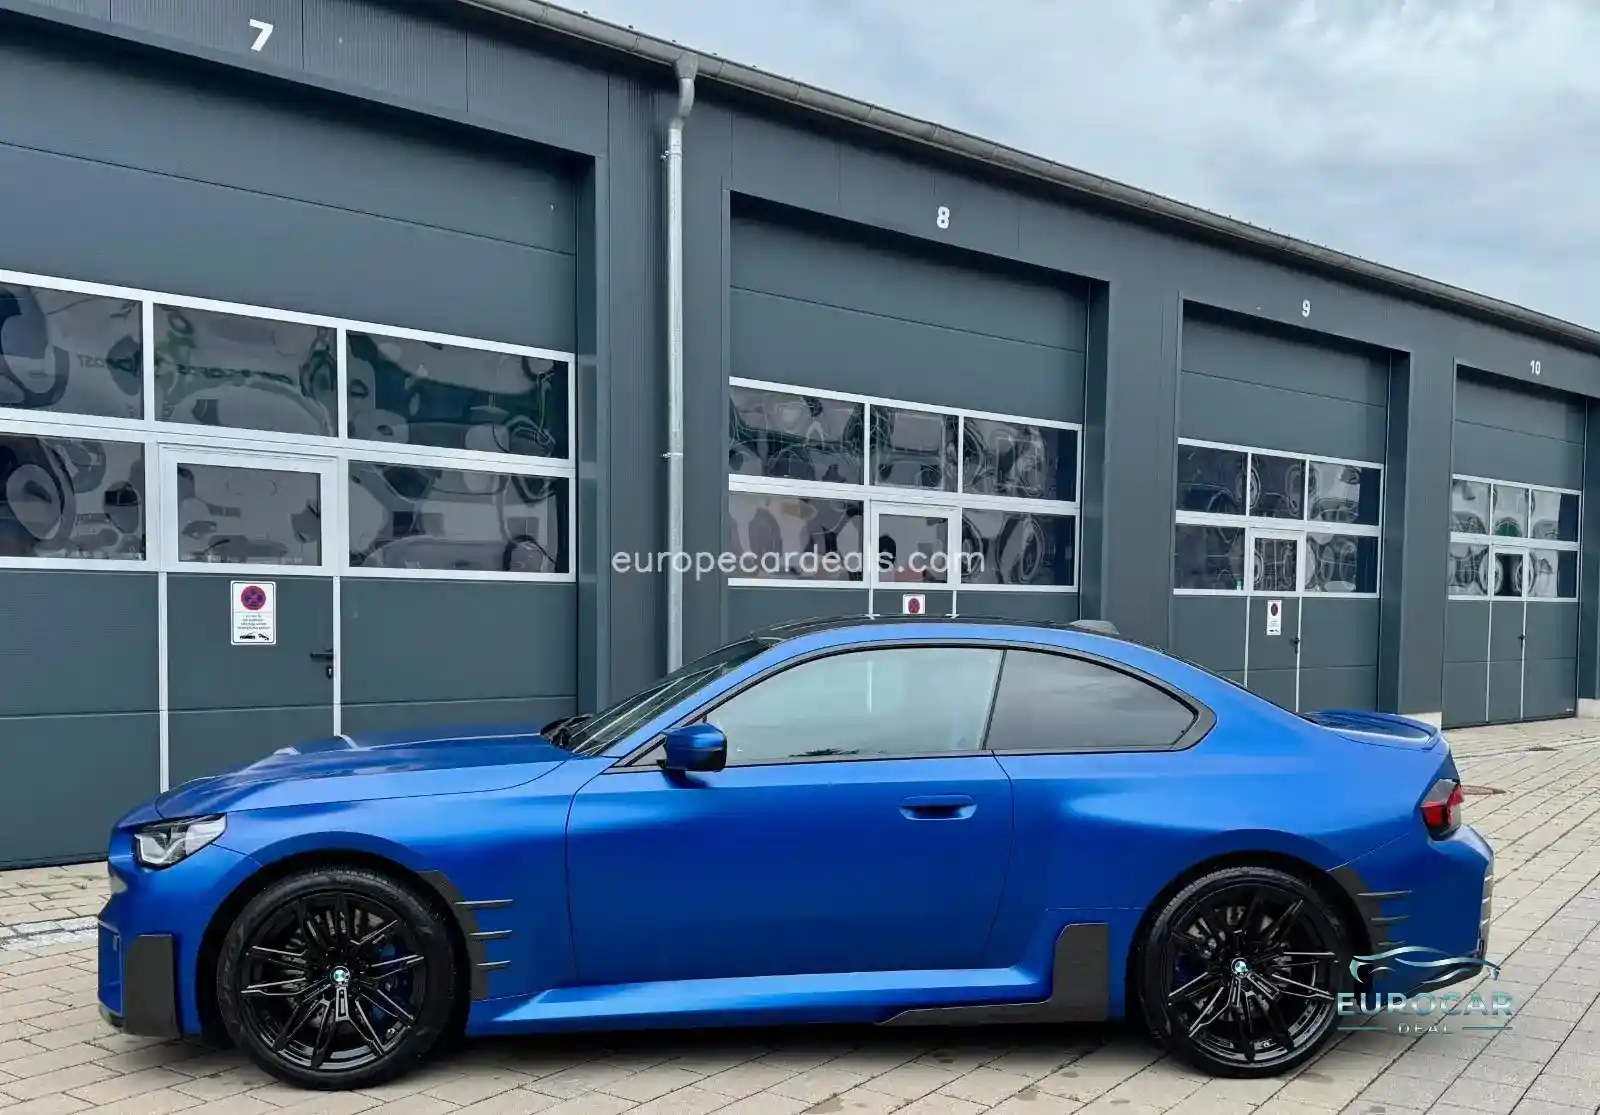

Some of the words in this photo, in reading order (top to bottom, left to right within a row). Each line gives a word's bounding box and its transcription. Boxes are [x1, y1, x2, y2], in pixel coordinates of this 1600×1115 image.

[249, 18, 274, 52] 7
[936, 205, 950, 229] 8
[1302, 299, 1311, 318] 9
[1530, 359, 1541, 376] 10
